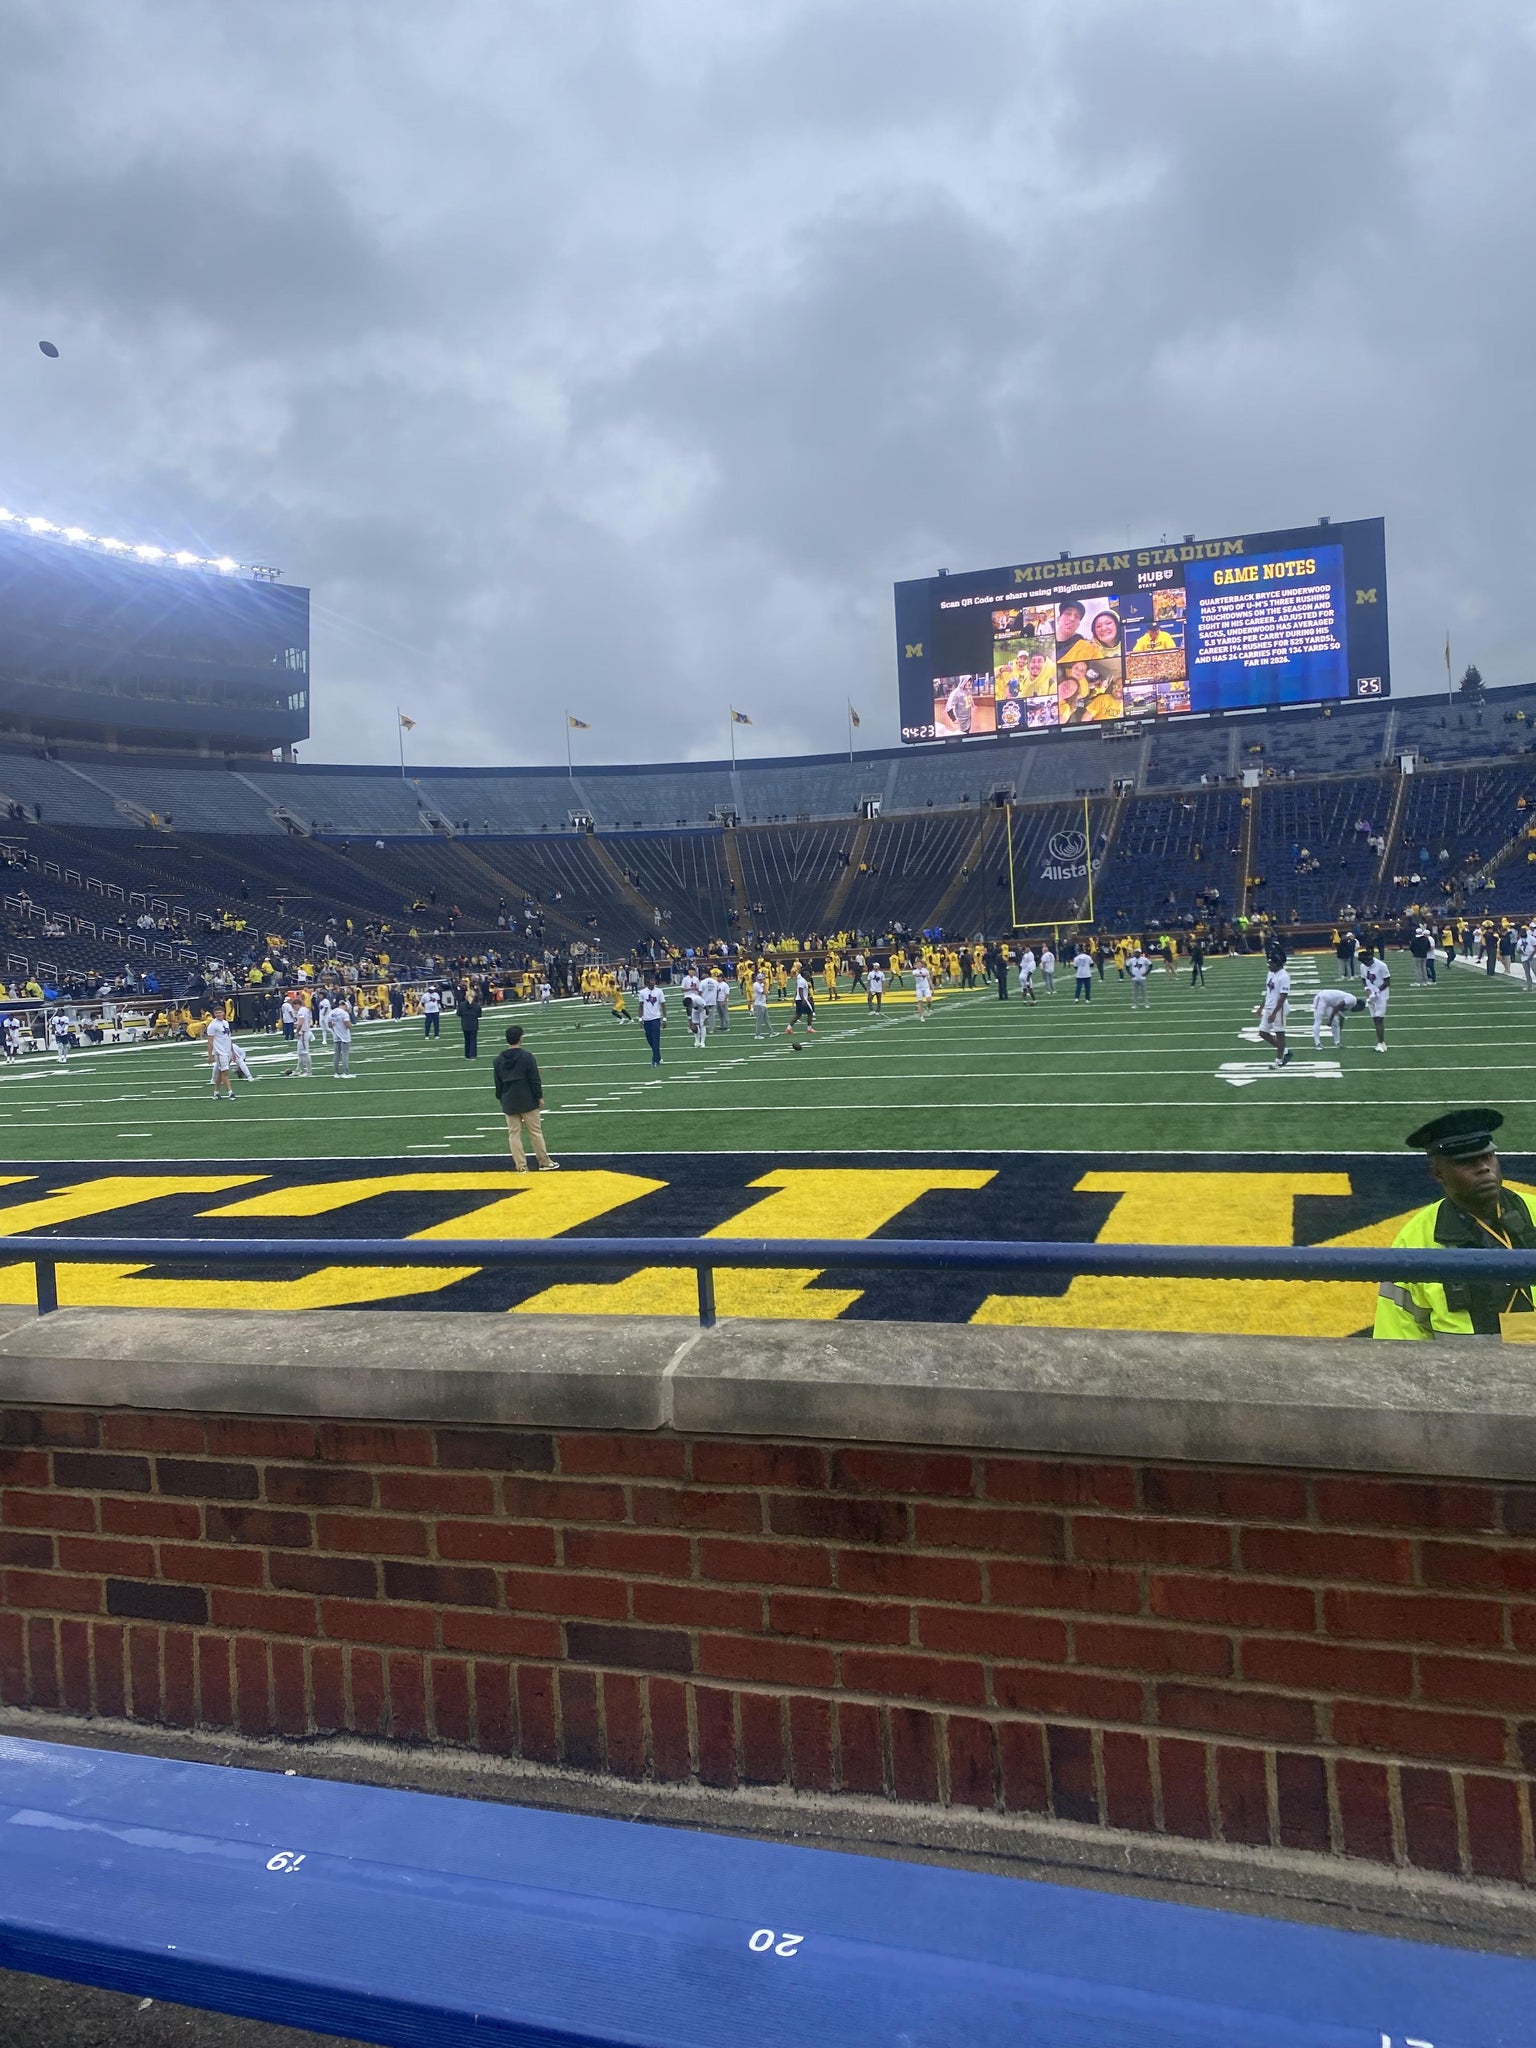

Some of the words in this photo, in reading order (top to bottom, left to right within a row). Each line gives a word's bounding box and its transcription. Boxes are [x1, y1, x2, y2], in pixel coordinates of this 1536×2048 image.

[1014, 554, 1130, 583] MICHIGAN
[1137, 539, 1244, 567] STADIUM
[1138, 570, 1163, 583] HUB
[1213, 566, 1258, 585] GAME
[1263, 559, 1316, 580] NOTES
[940, 601, 960, 609] Scan
[961, 598, 973, 607] QR
[974, 596, 994, 605] Code
[1006, 591, 1028, 600] share
[1029, 588, 1052, 598] using
[1053, 580, 1113, 595] #BigHouseLive
[1200, 595, 1254, 606] QUARTERBACK
[1256, 591, 1280, 600] BRYCE
[1282, 585, 1331, 596] UNDERWOOD
[1201, 606, 1216, 614] HAS
[1270, 598, 1295, 606] THREE
[1296, 593, 1330, 603] RUSHING
[1356, 588, 1377, 604] M
[1201, 611, 1253, 622] TOUCHDOWNS
[1282, 605, 1313, 613] SEASON
[1314, 602, 1330, 610] AND
[1198, 623, 1220, 631] EIGHT
[1245, 618, 1277, 626] CAREER.
[1278, 613, 1318, 622] ADJUSTED
[1227, 625, 1275, 636] UNDERWOOD
[1276, 622, 1292, 630] HAS
[1293, 618, 1333, 628] AVERAGED
[1217, 637, 1241, 645] YARDS
[1259, 632, 1284, 640] CARRY
[1286, 629, 1314, 637] DURING
[905, 643, 923, 658] M
[1195, 656, 1211, 664] AND
[1212, 654, 1227, 662] HAS
[1239, 650, 1271, 659] CARRIES
[1272, 648, 1287, 656] FOR
[1199, 647, 1228, 655] CAREER
[1243, 642, 1272, 650] RUSHES
[902, 725, 935, 738] 94:23
[748, 1928, 804, 1957] 20
